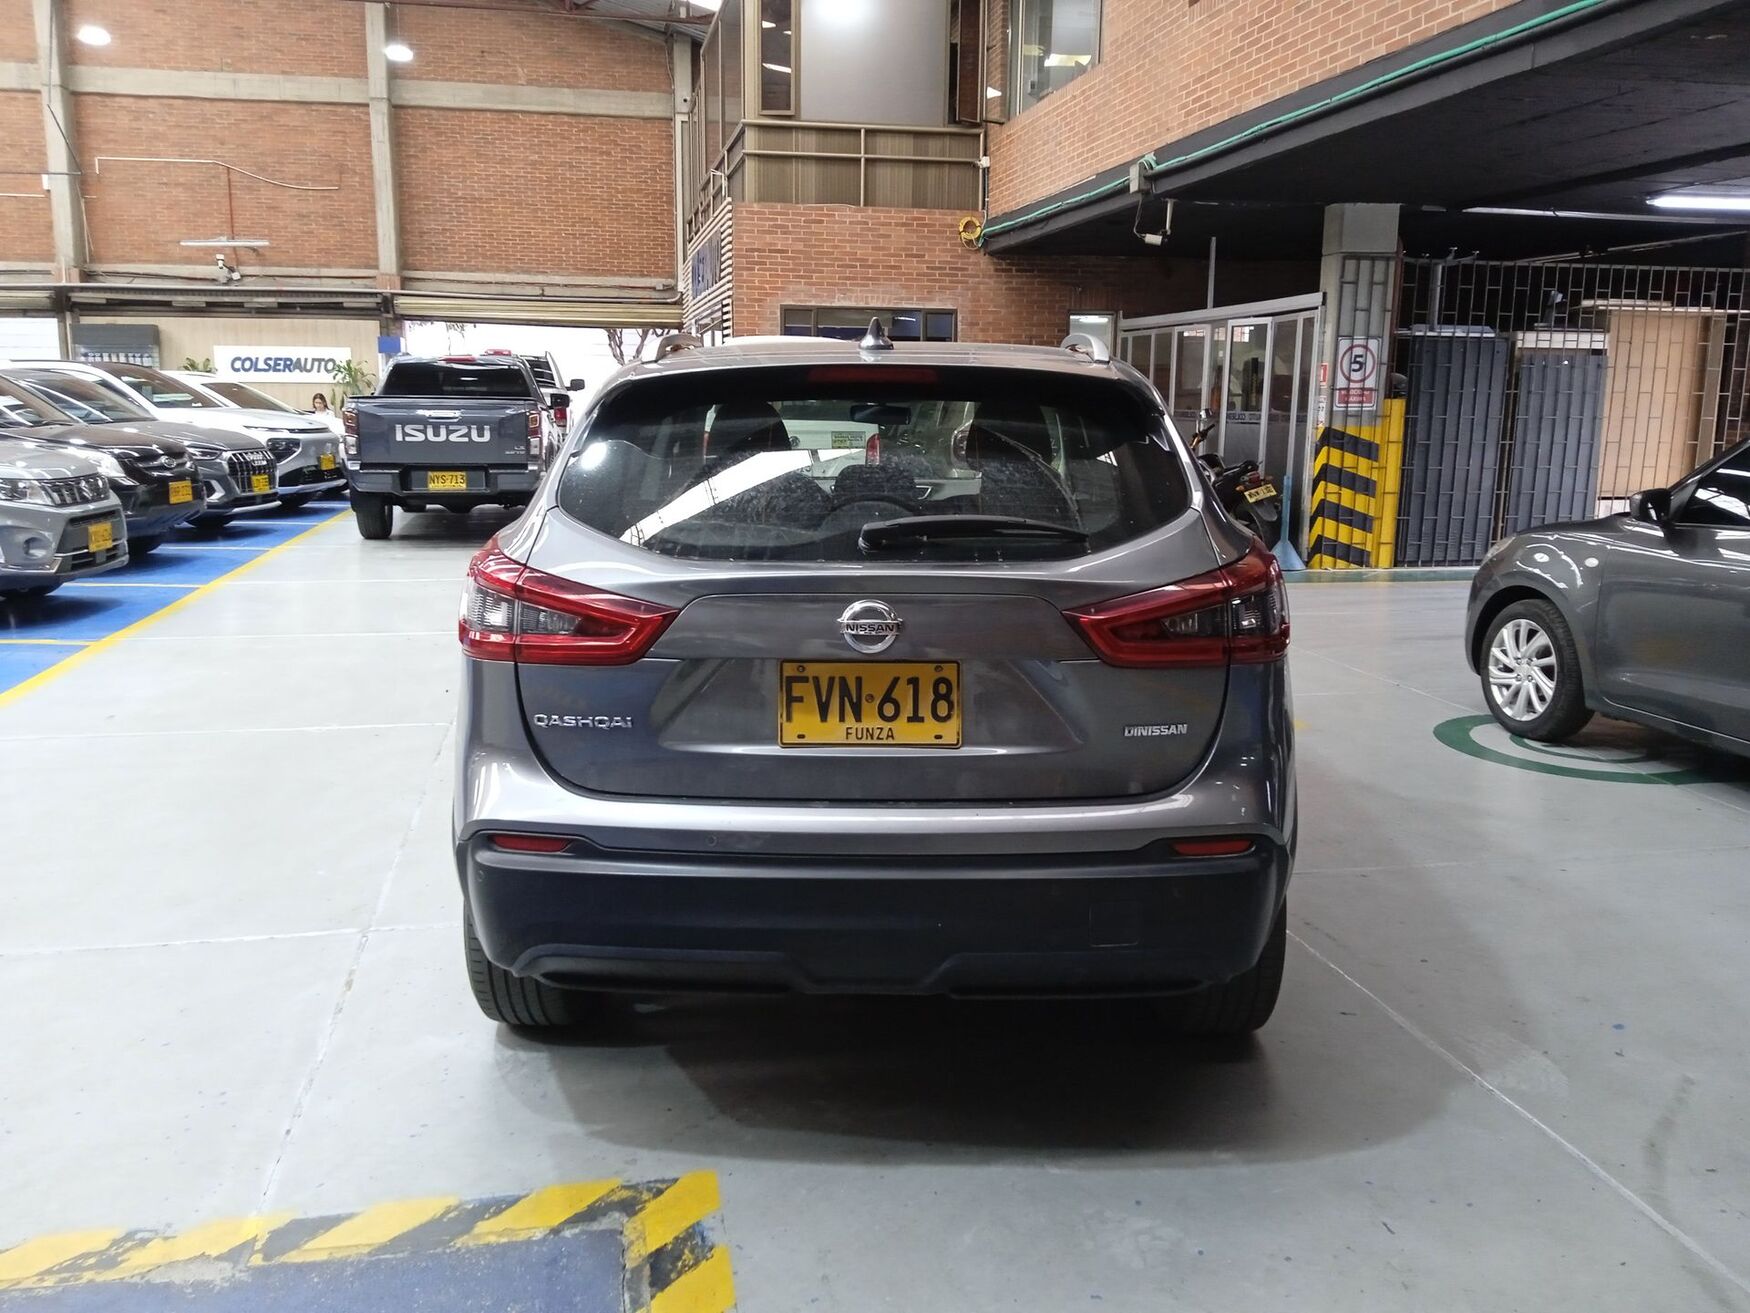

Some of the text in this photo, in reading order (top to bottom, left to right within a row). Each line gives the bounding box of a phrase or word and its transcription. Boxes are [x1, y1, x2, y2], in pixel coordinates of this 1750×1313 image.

[230, 356, 337, 374] COLSERAUTO
[1351, 354, 1364, 372] 5
[394, 424, 491, 443] ISUZU
[845, 623, 896, 633] NISSAN
[845, 726, 895, 741] FUNZA
[1124, 723, 1188, 737] DINISSAN
